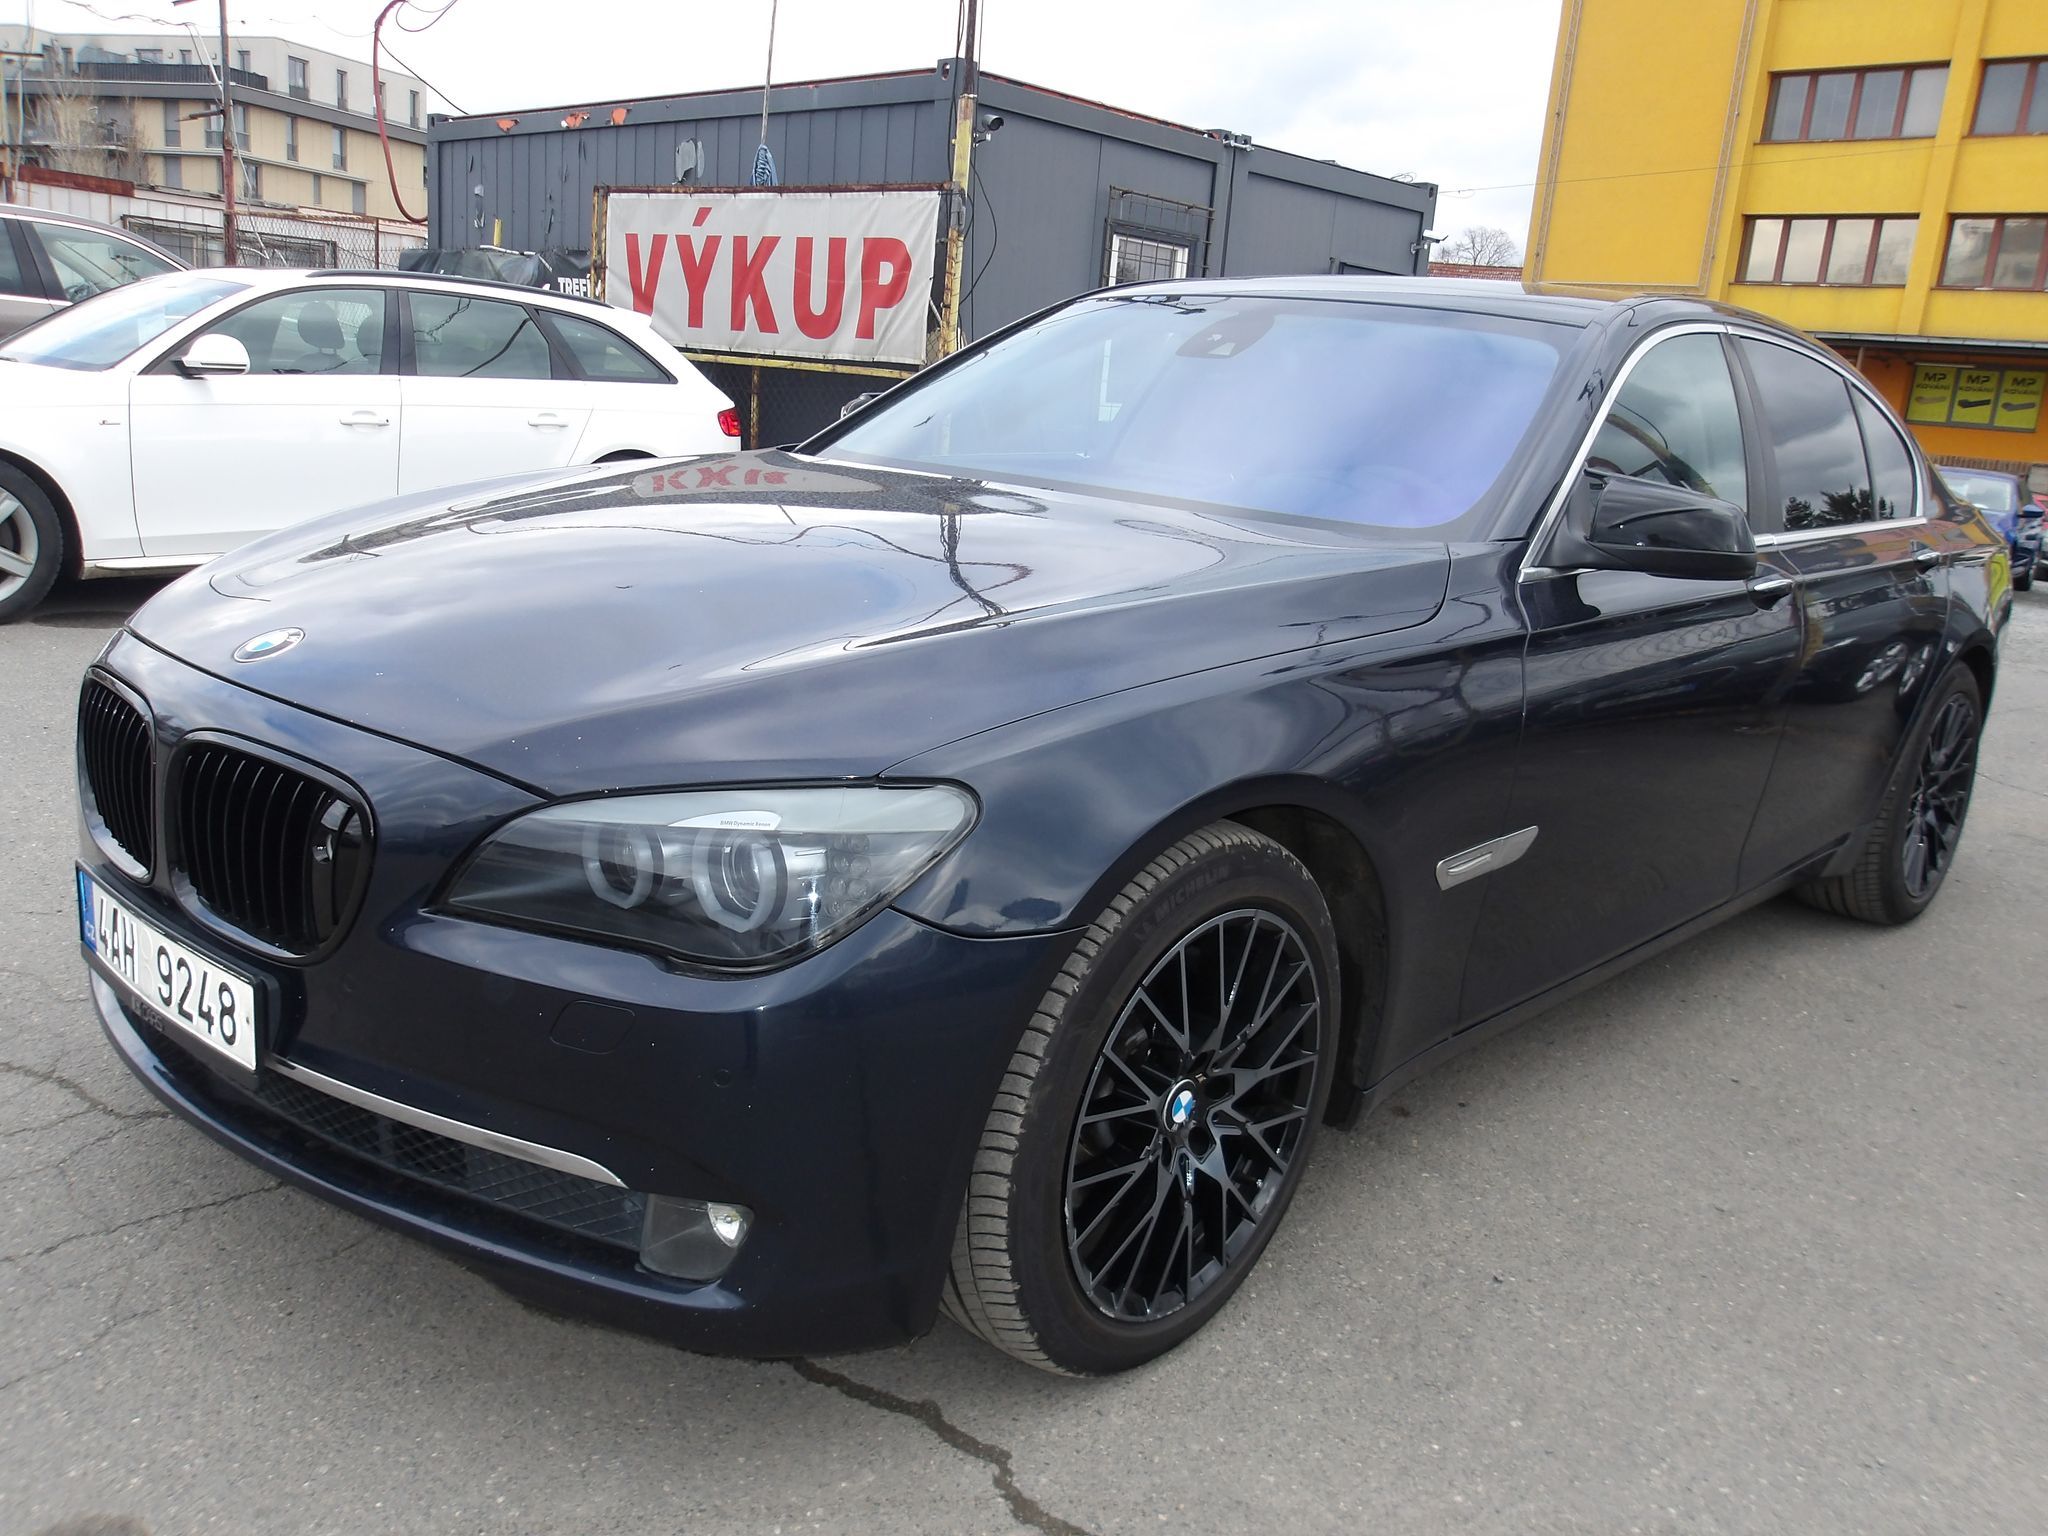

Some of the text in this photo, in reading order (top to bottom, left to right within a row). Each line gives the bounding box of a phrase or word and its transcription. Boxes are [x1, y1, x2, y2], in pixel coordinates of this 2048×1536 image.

[624, 207, 912, 340] VÝKUP
[1923, 372, 1947, 382] MP
[1966, 375, 1991, 385] MP
[2011, 377, 2037, 387] MP
[100, 897, 136, 985] 4AH
[157, 945, 236, 1046] 9248
